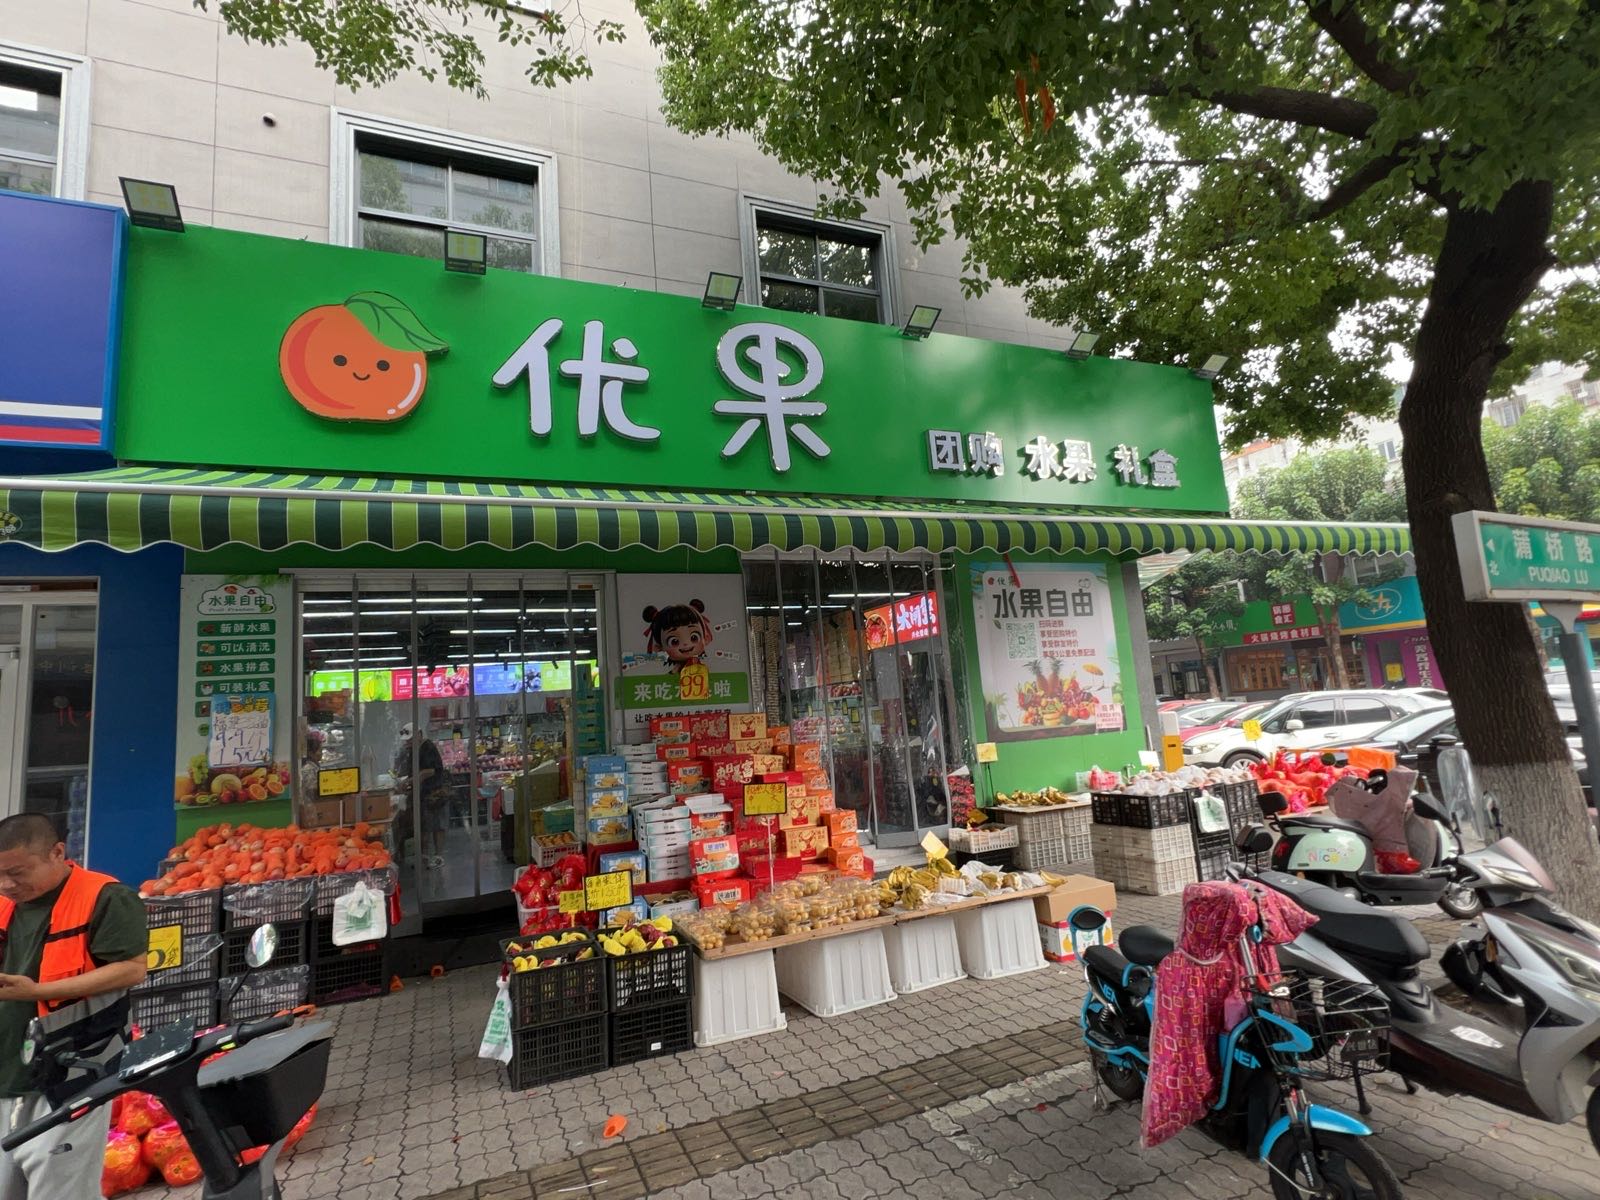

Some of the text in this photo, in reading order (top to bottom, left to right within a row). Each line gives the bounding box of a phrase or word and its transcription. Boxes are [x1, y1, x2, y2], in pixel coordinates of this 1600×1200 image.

[492, 318, 832, 473] 优果
[926, 429, 1182, 488] 团购 水果 礼盒
[1512, 528, 1594, 564] 蒲桥路
[1528, 566, 1589, 584] PUQIAO LU
[208, 595, 267, 606] 水果自由
[992, 588, 1094, 618] 水果自由
[220, 623, 270, 633] 新鲜水果
[221, 643, 270, 653] 可以清洗
[220, 681, 270, 692] 可装礼盒
[634, 680, 731, 702] 来吃啦
